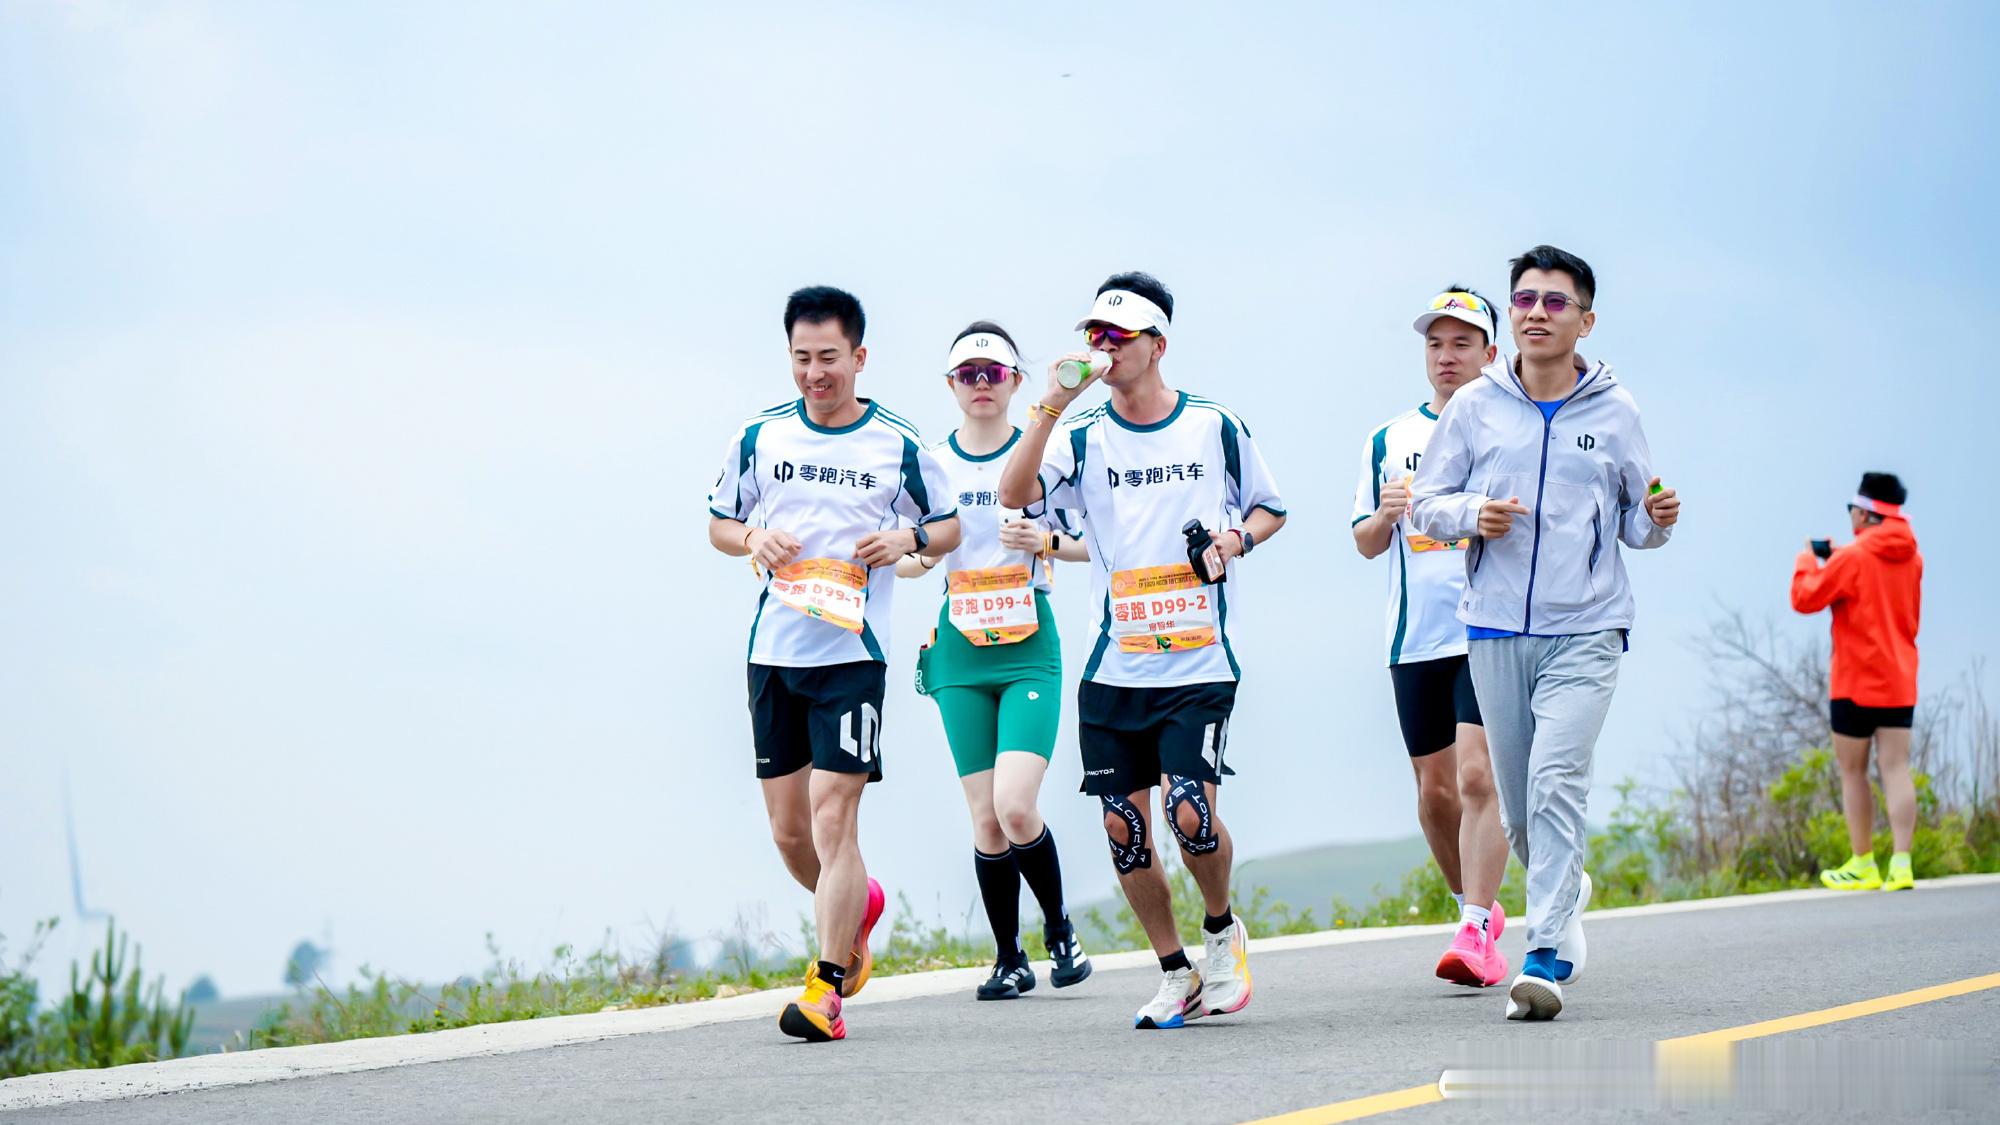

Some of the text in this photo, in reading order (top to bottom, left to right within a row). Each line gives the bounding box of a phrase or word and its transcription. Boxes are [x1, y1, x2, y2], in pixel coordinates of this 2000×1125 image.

[799, 464, 877, 490] 零跑汽车
[1124, 462, 1205, 488] 零跑汽车
[951, 593, 1032, 616] 零跑 D99-4
[1115, 594, 1208, 622] 零跑 D99-2
